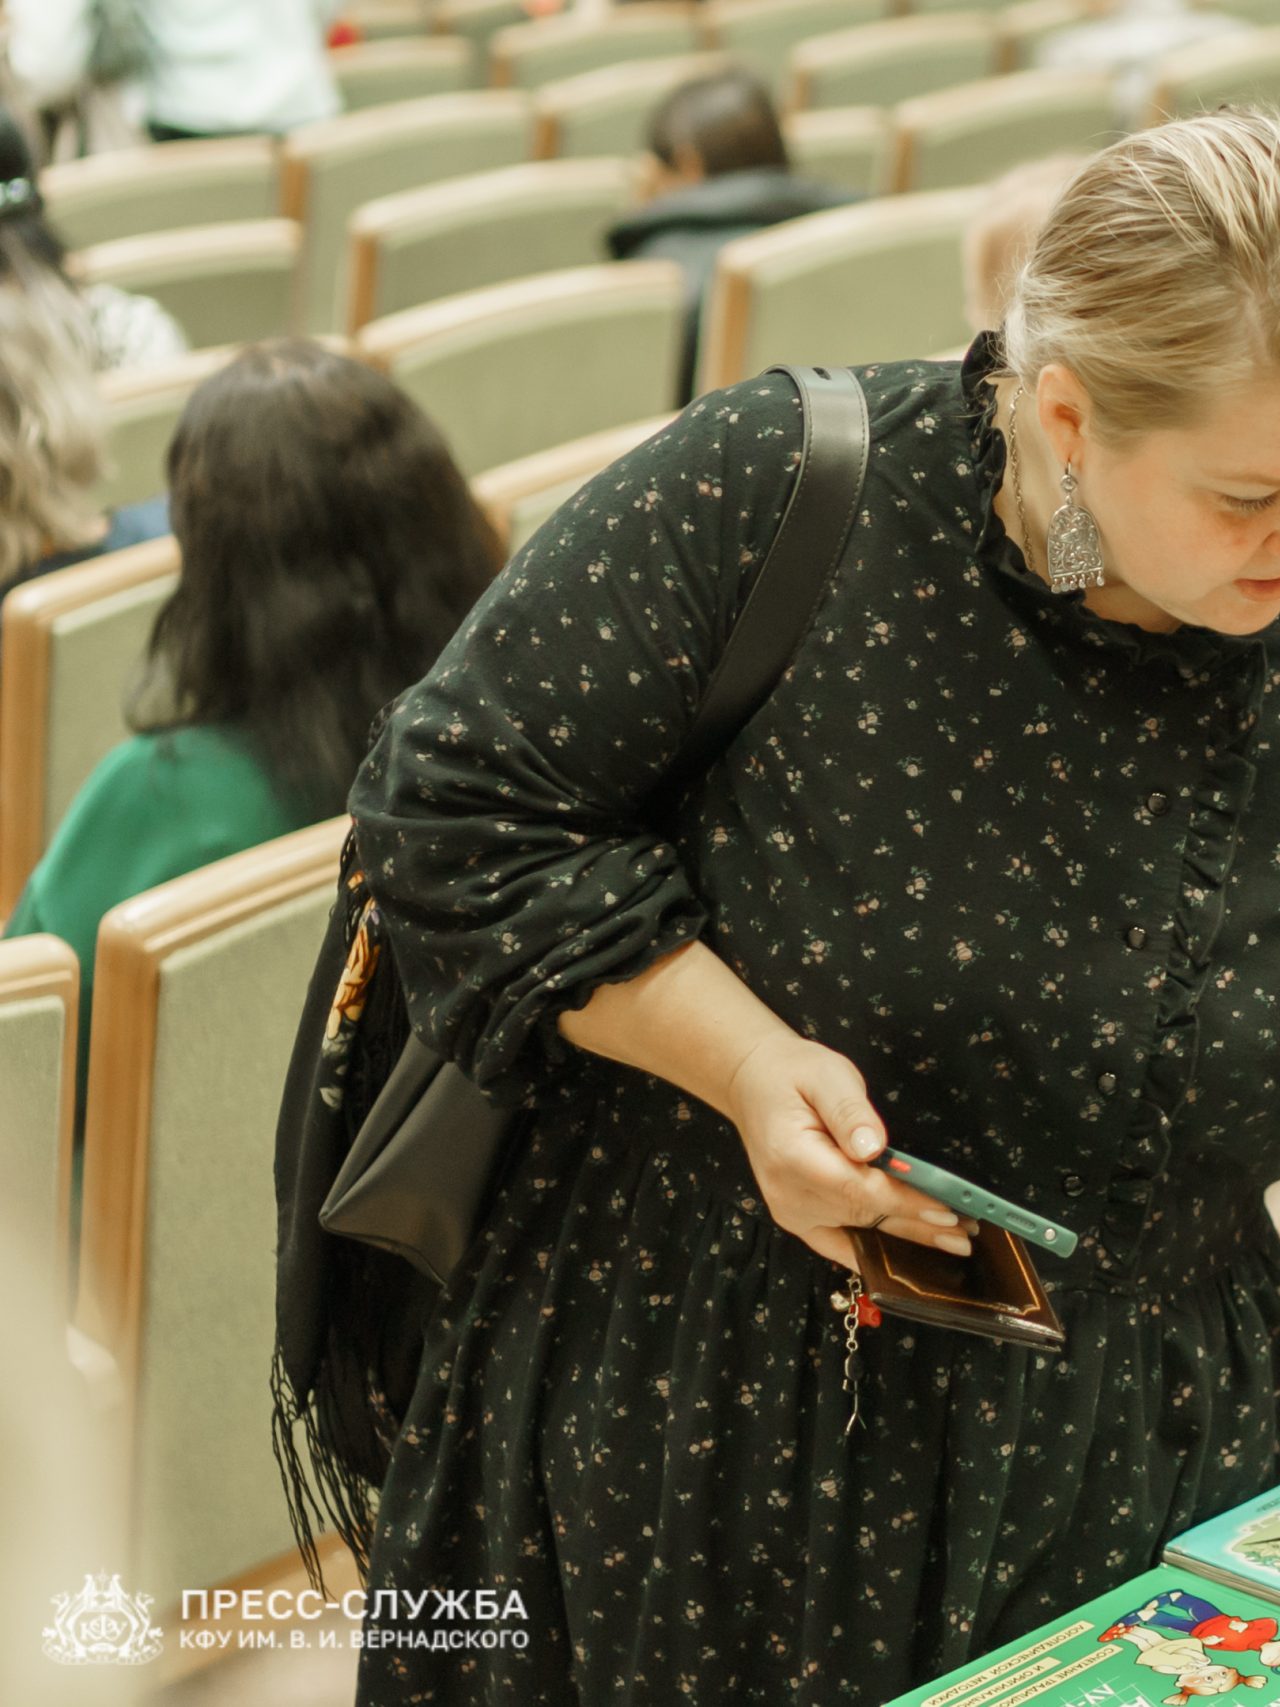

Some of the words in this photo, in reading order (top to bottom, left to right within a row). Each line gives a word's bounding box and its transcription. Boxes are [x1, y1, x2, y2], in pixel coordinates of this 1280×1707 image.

[989, 1624, 1085, 1676] ЛОГОПЕДИЧЕСКОЙ
[1055, 1647, 1115, 1680] СОЧЕТАНИЕ
[928, 1675, 988, 1706] МЕТОДИКИ
